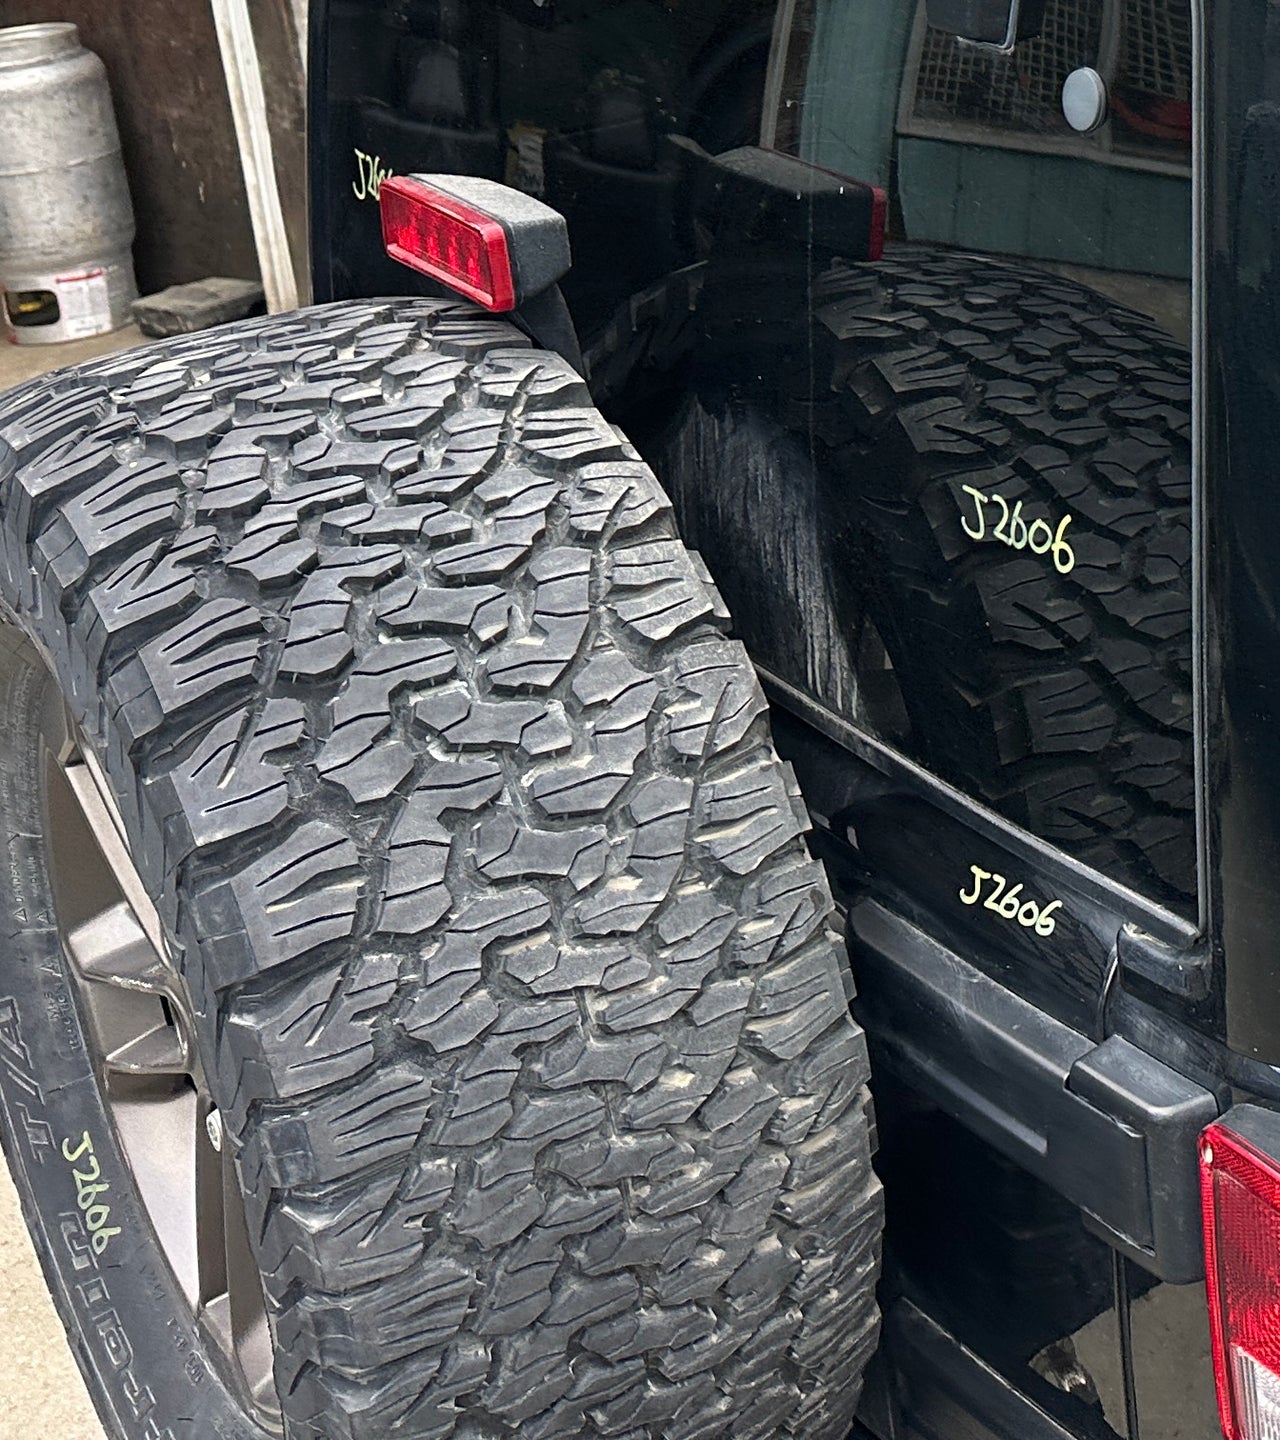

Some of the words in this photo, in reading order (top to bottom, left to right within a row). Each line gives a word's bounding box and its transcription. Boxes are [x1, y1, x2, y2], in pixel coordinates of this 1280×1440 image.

[961, 484, 1075, 574] J2606
[959, 864, 1063, 936] J2606
[62, 1130, 122, 1255] J2606
